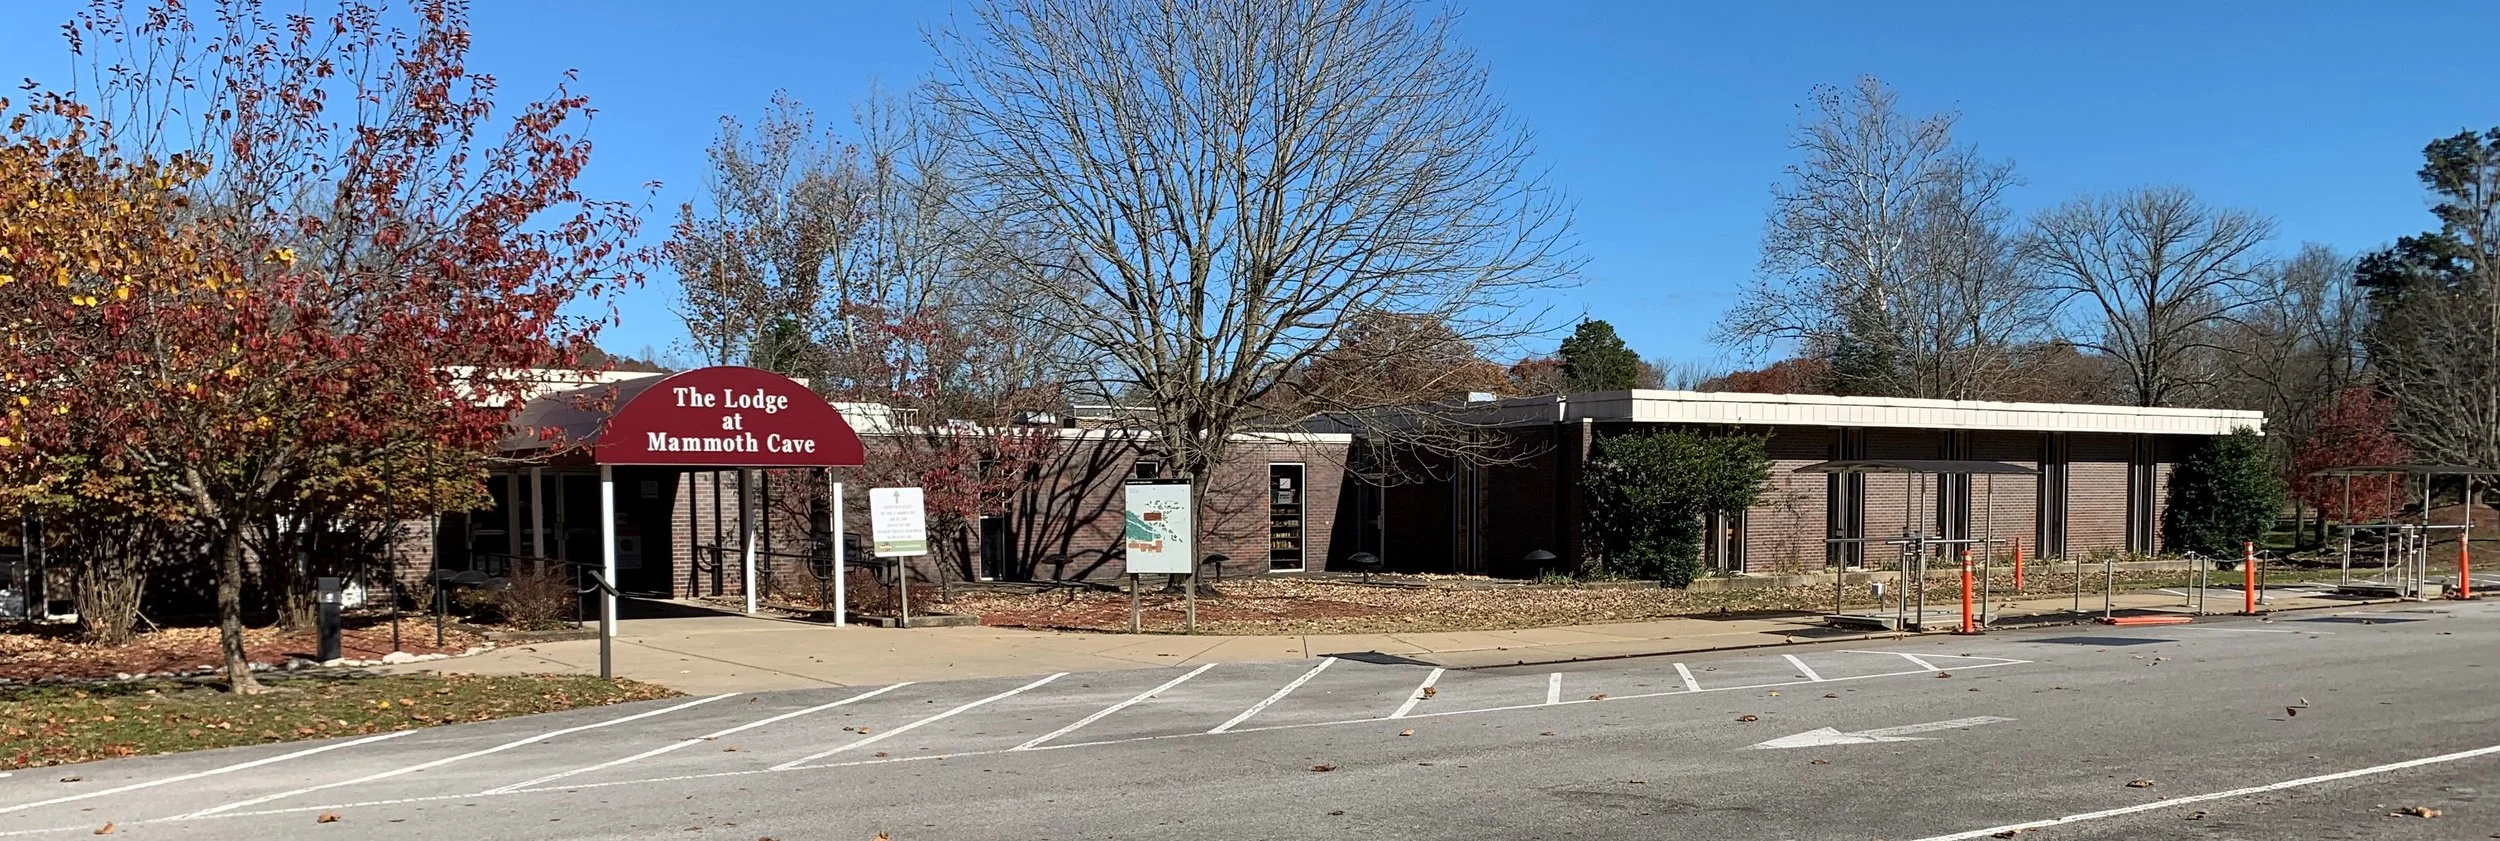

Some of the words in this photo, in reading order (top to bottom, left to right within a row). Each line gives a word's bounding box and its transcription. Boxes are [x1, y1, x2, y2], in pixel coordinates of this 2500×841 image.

[673, 386, 716, 408] The
[723, 388, 789, 414] Lodge
[722, 413, 743, 431] at
[646, 431, 759, 453] Mammoth
[766, 433, 816, 454] Cave
